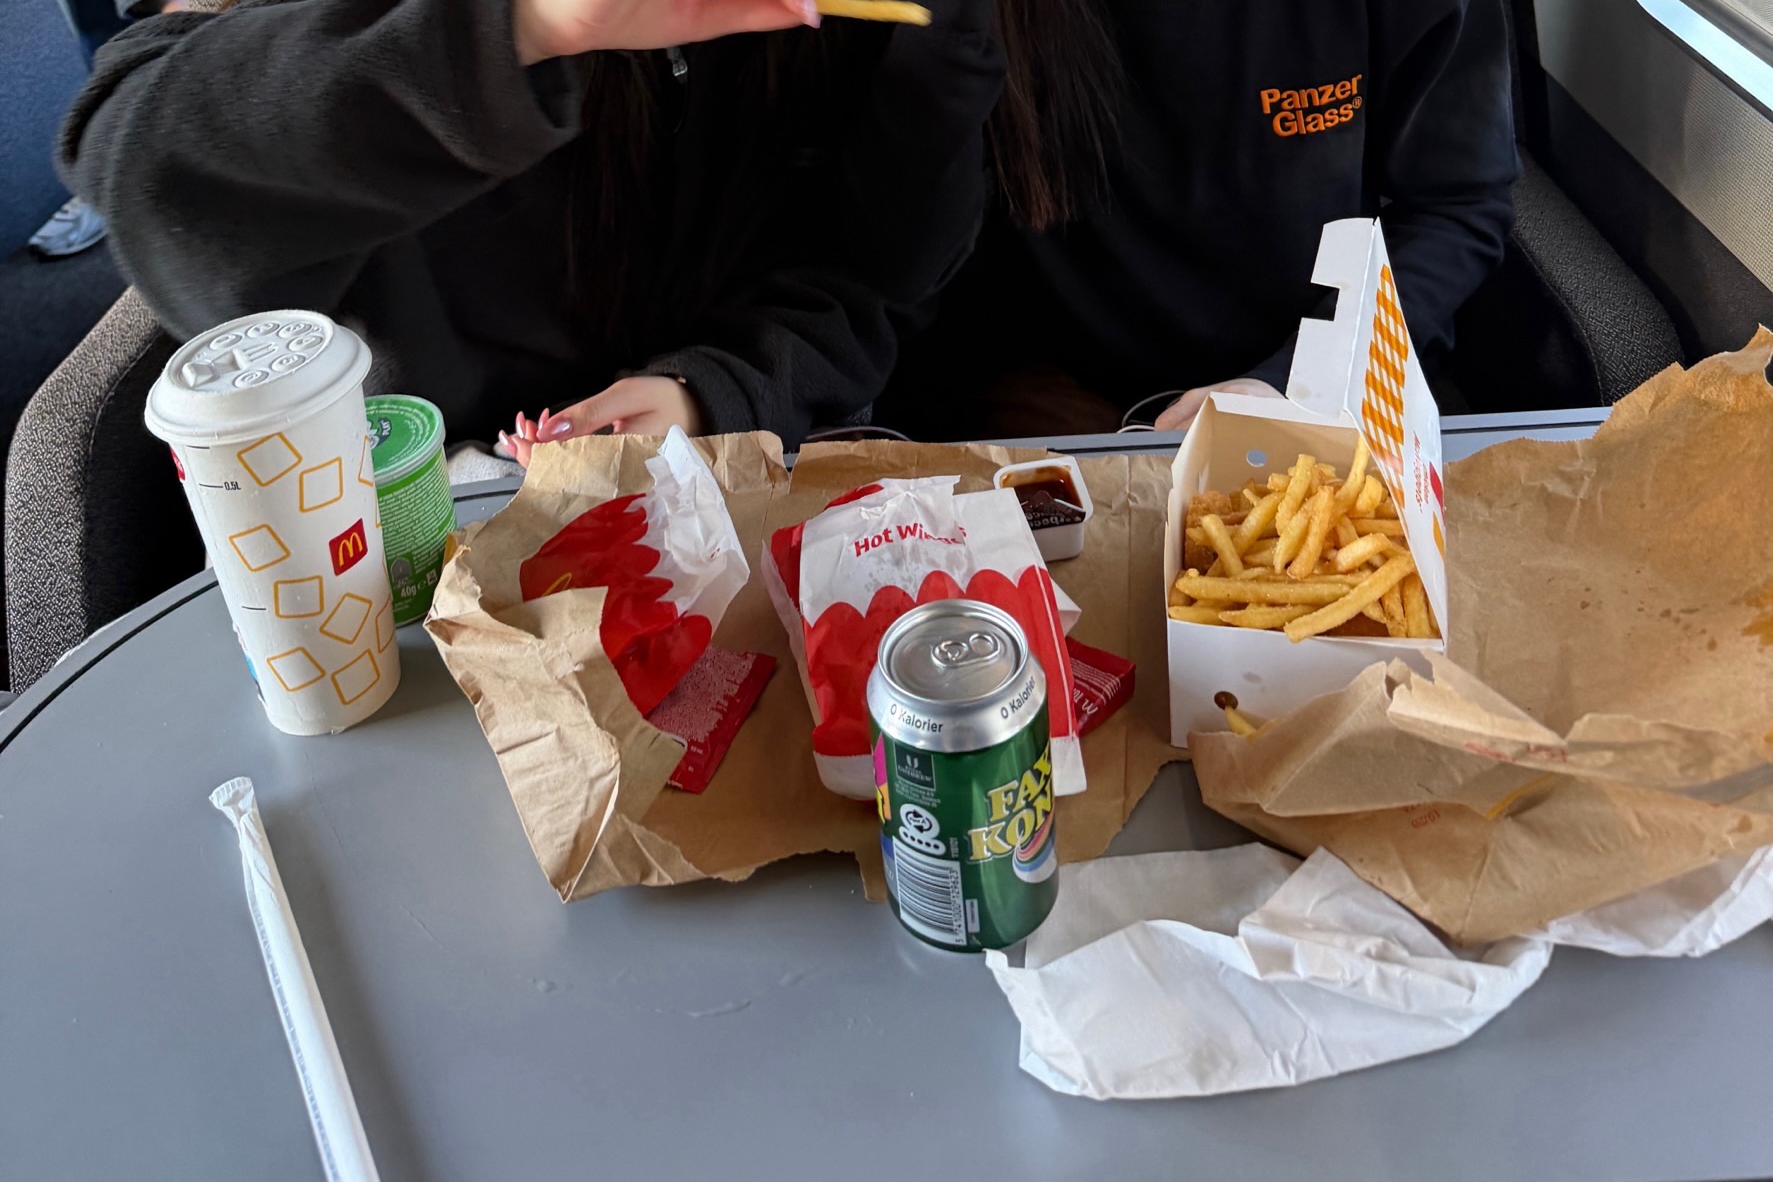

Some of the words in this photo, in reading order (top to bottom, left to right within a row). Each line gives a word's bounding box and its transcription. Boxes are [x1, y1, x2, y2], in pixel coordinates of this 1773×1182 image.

[1260, 74, 1362, 114] Panzer
[854, 528, 894, 557] Hot
[1010, 676, 1036, 713] Kalorier
[899, 709, 944, 732] Kalorier
